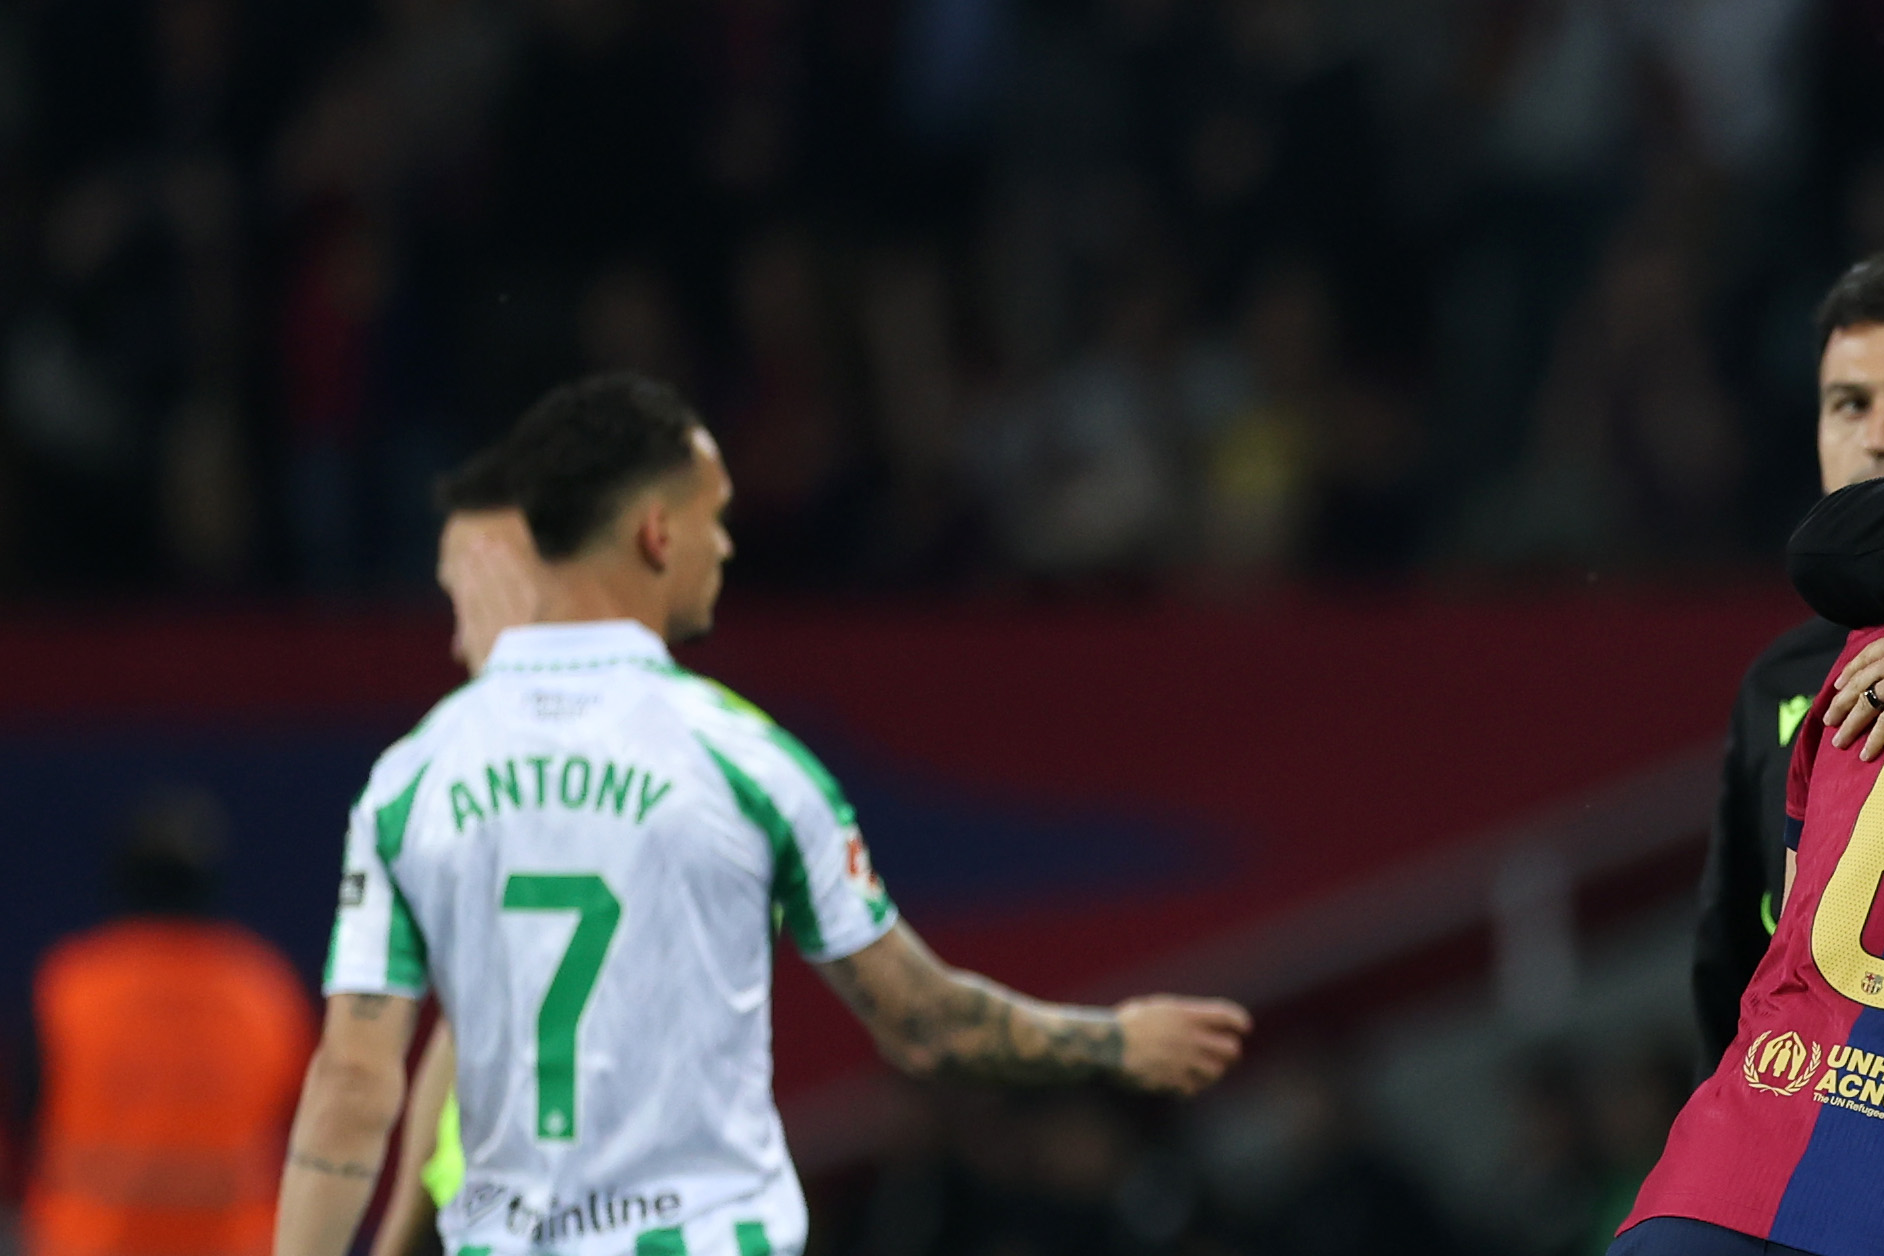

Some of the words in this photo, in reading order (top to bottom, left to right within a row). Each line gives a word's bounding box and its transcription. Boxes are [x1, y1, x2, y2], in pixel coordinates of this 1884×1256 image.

[449, 754, 674, 834] ANTONY
[502, 874, 621, 1139] 7
[1813, 1092, 1829, 1103] The
[1830, 1097, 1846, 1107] UN
